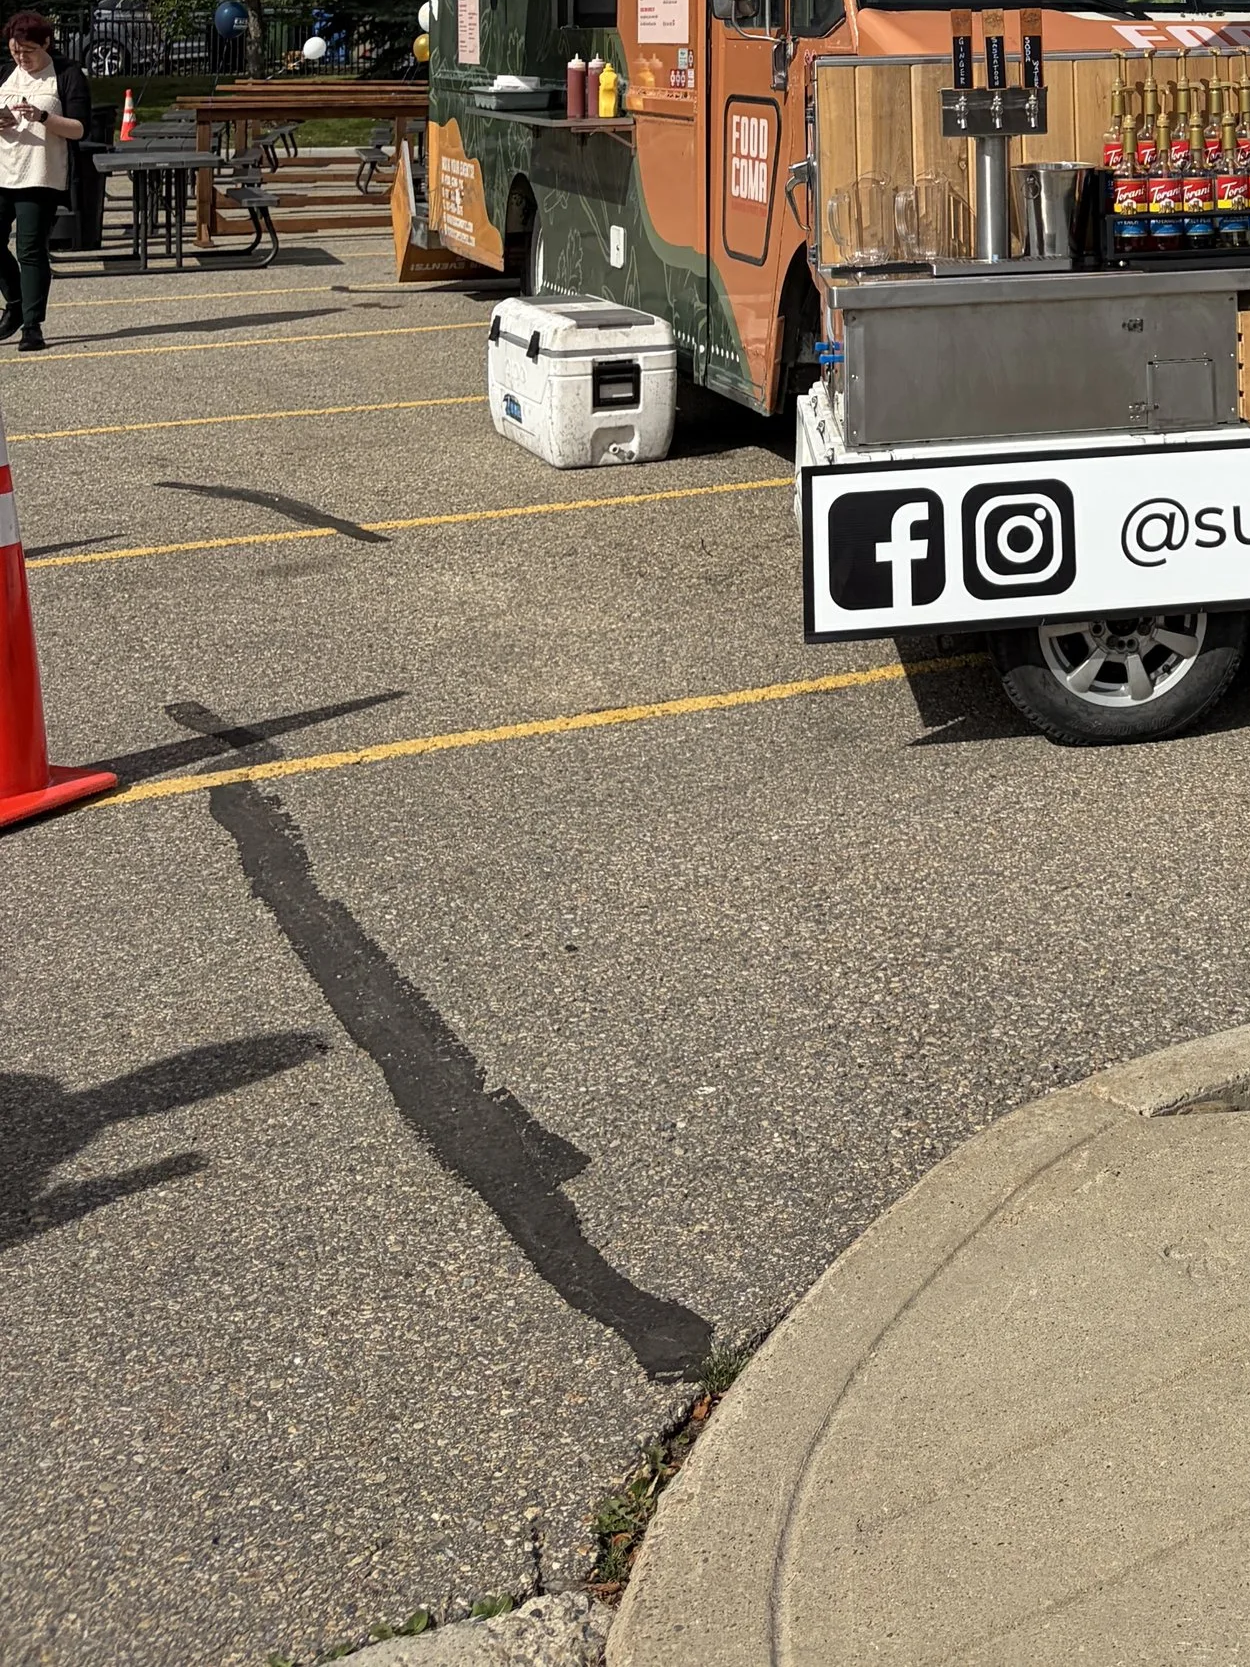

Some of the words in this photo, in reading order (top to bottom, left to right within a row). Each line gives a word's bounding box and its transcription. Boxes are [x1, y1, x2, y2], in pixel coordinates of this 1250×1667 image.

[958, 37, 966, 85] GINGER
[1024, 36, 1032, 62] SODA
[731, 114, 769, 160] FOOD
[731, 157, 768, 204] COMA
[1114, 184, 1146, 205] Torani
[1182, 183, 1211, 204] Torani
